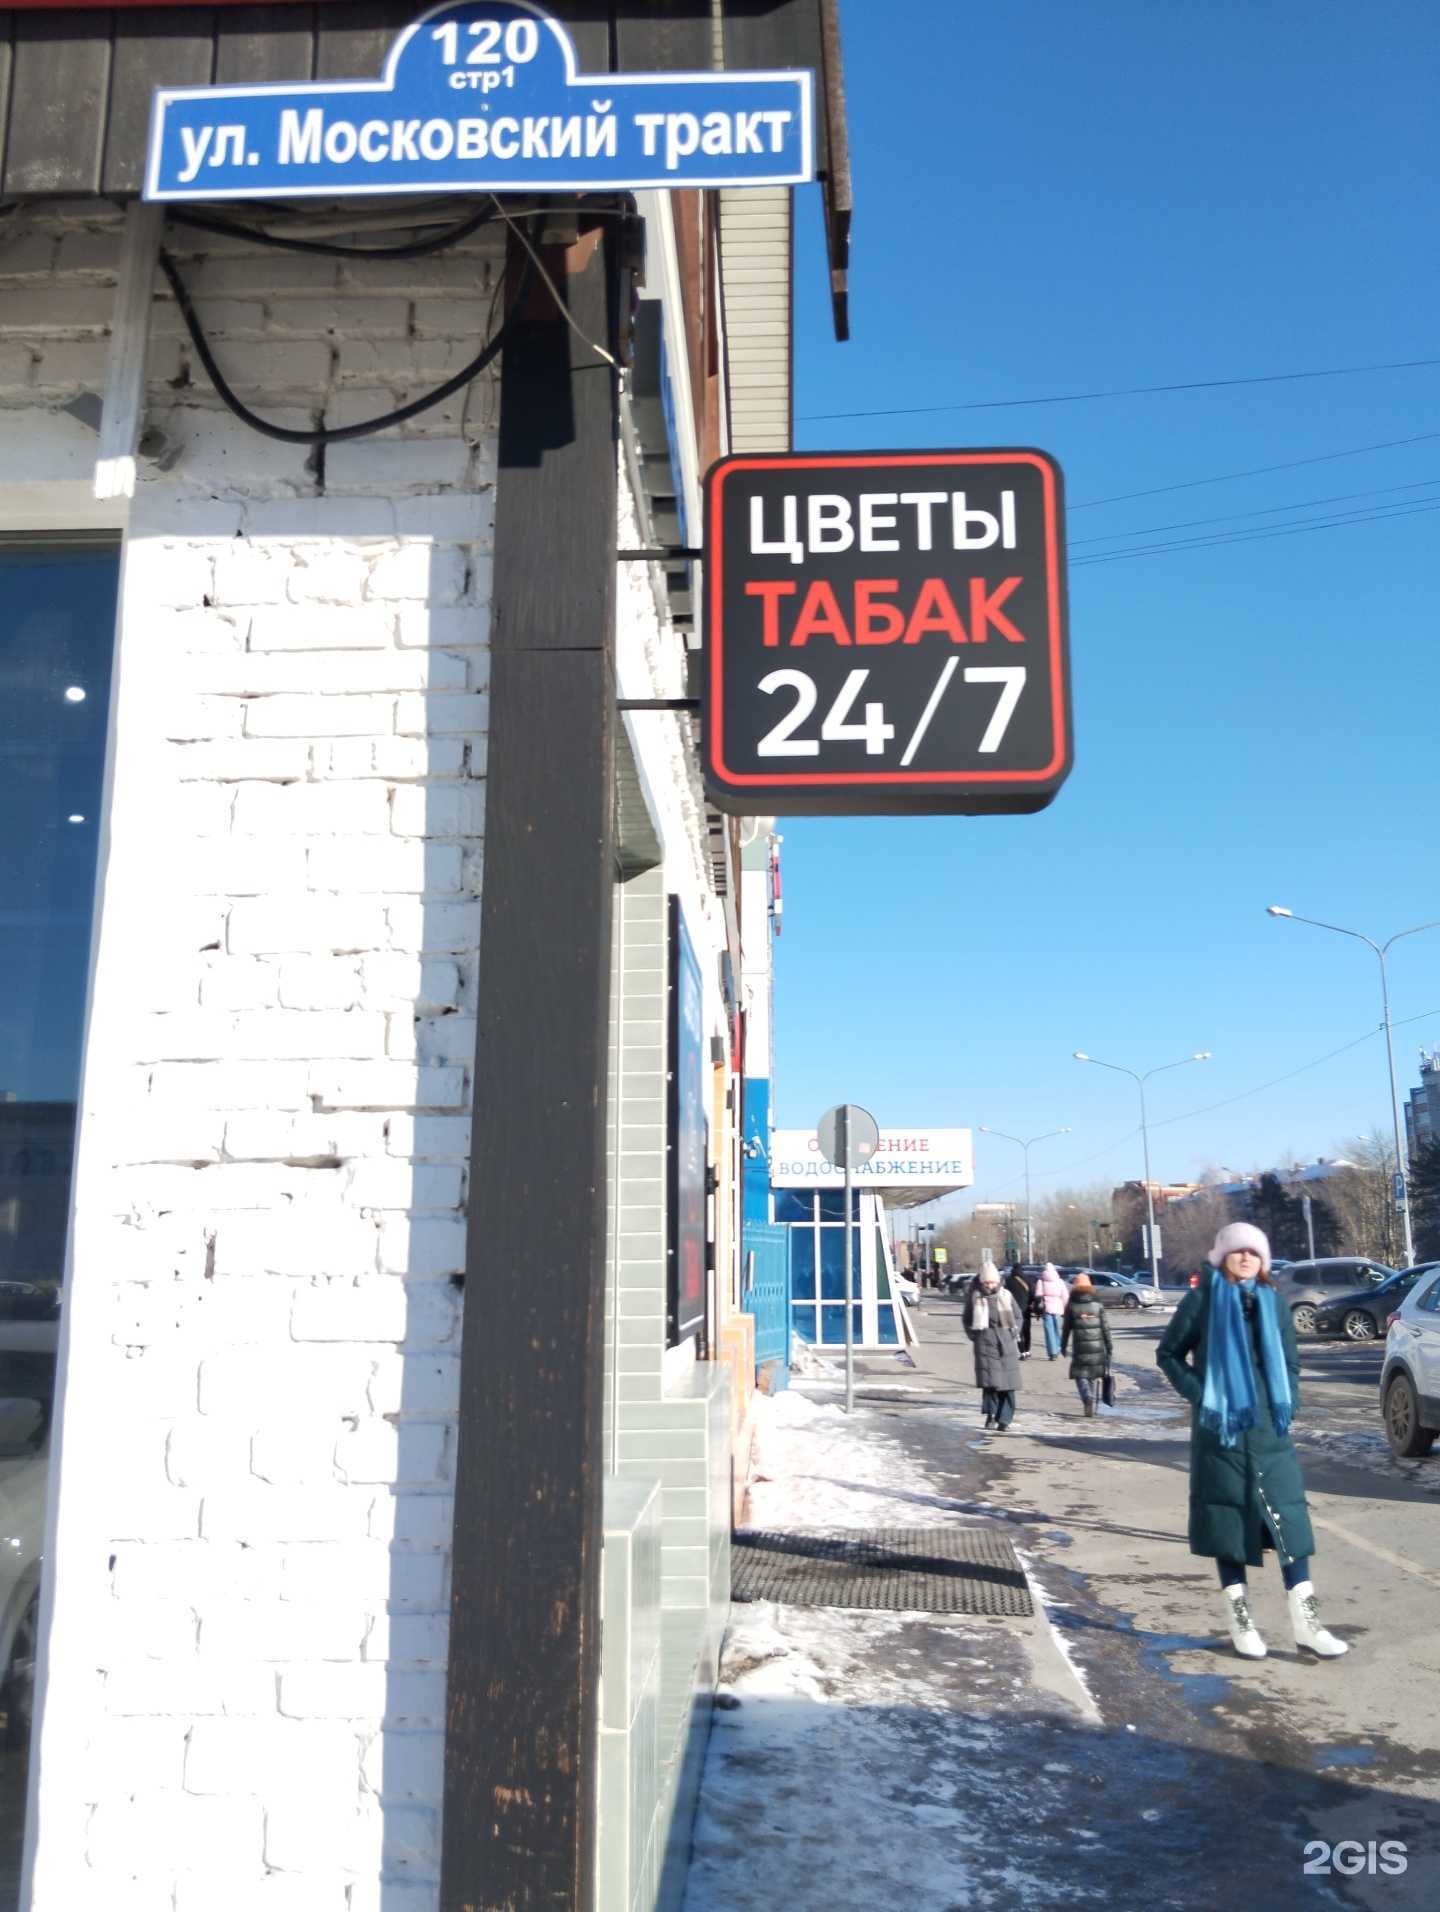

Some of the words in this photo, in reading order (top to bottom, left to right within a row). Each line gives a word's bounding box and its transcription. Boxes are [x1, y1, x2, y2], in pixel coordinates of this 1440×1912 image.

[431, 19, 539, 65] 120
[448, 67, 515, 94] стр1
[177, 125, 260, 182] ул.
[277, 99, 618, 165] Московский
[633, 109, 792, 170] тракт
[750, 490, 1017, 564] ЦВЕТЫ
[745, 576, 1026, 647] ТАБАК
[757, 655, 1027, 767] 24/7
[779, 1160, 963, 1176] ВОДОСАБЖЕНИЕ
[807, 1138, 930, 1152] ОЕНИЕ
